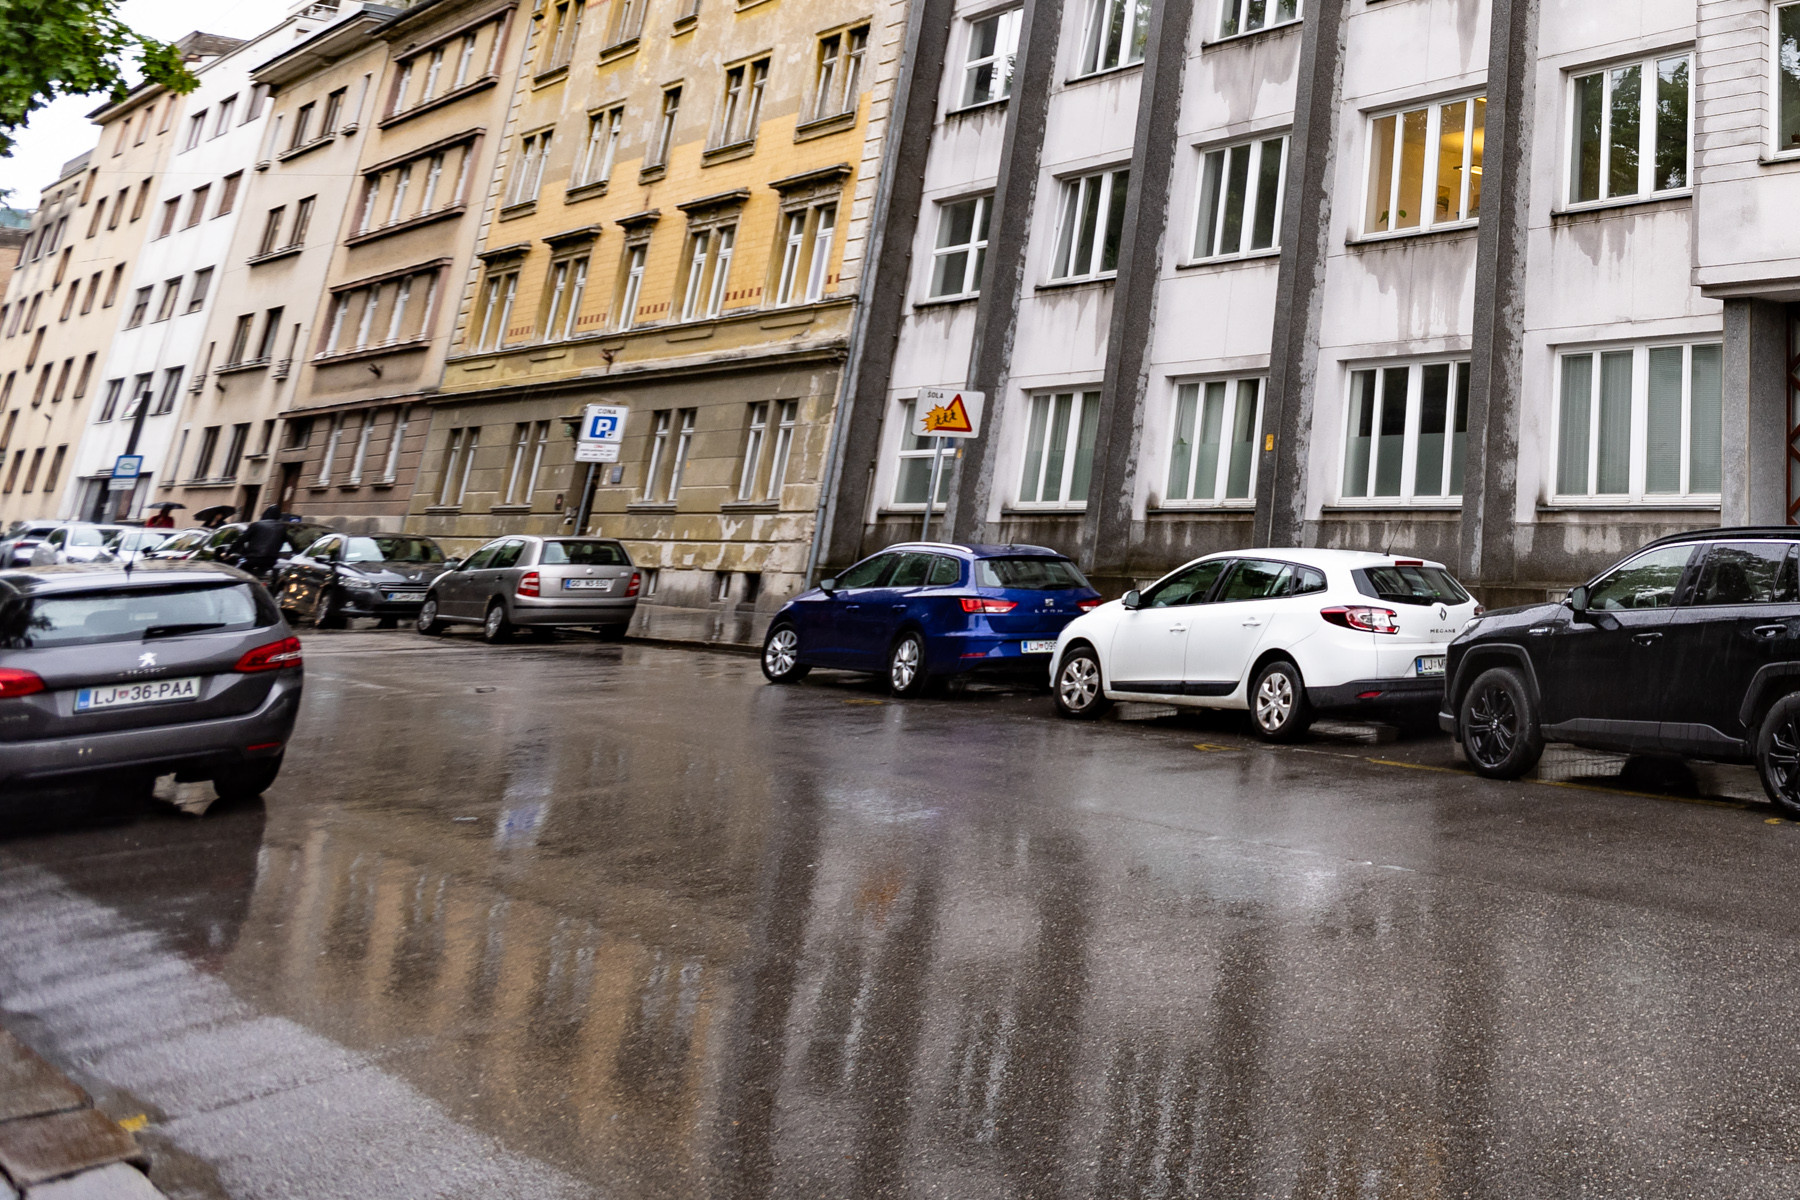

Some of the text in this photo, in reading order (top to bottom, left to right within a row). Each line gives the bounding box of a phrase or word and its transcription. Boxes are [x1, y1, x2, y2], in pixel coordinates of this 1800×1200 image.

[595, 418, 612, 436] P
[93, 680, 193, 705] LJ 36-PAA
